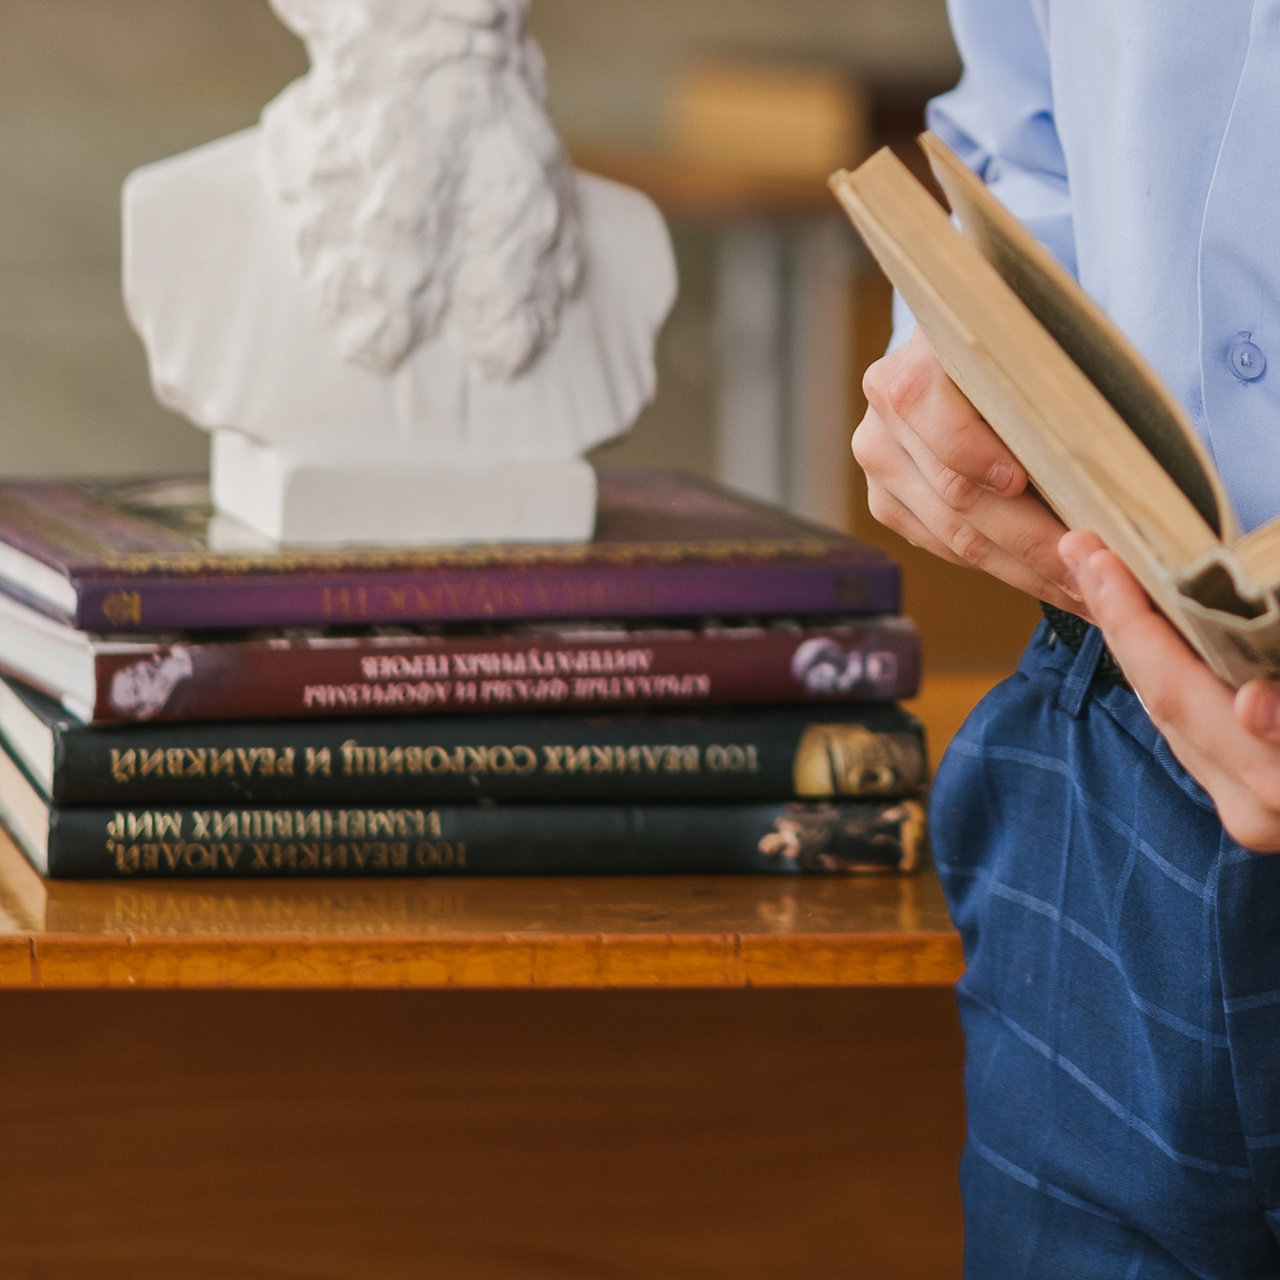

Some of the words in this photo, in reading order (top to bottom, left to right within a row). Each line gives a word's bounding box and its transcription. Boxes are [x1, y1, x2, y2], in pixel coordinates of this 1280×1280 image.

[360, 653, 449, 679] ГЕРОЕВ
[453, 648, 653, 677] ЛИТЕРАТУРНЫХ
[302, 680, 450, 706] АФОРИЗМЫ
[454, 680, 476, 701] И
[480, 676, 567, 700] ФРАЗЫ
[572, 673, 710, 697] КРЫЛАТЫЕ
[110, 747, 294, 782] РЕЛИКВИЙ
[305, 747, 331, 774] И
[340, 739, 537, 775] СОКРОВИЩ
[542, 744, 699, 773] ВЕЛИКИХ
[705, 744, 757, 773] 100
[105, 811, 181, 839] МИР
[191, 808, 440, 837] ИЗМЕНИВШИХ
[105, 838, 240, 872] ЛЮДЕЙ,
[253, 842, 407, 867] ВЕЛИКИХ
[416, 841, 465, 867] 100
